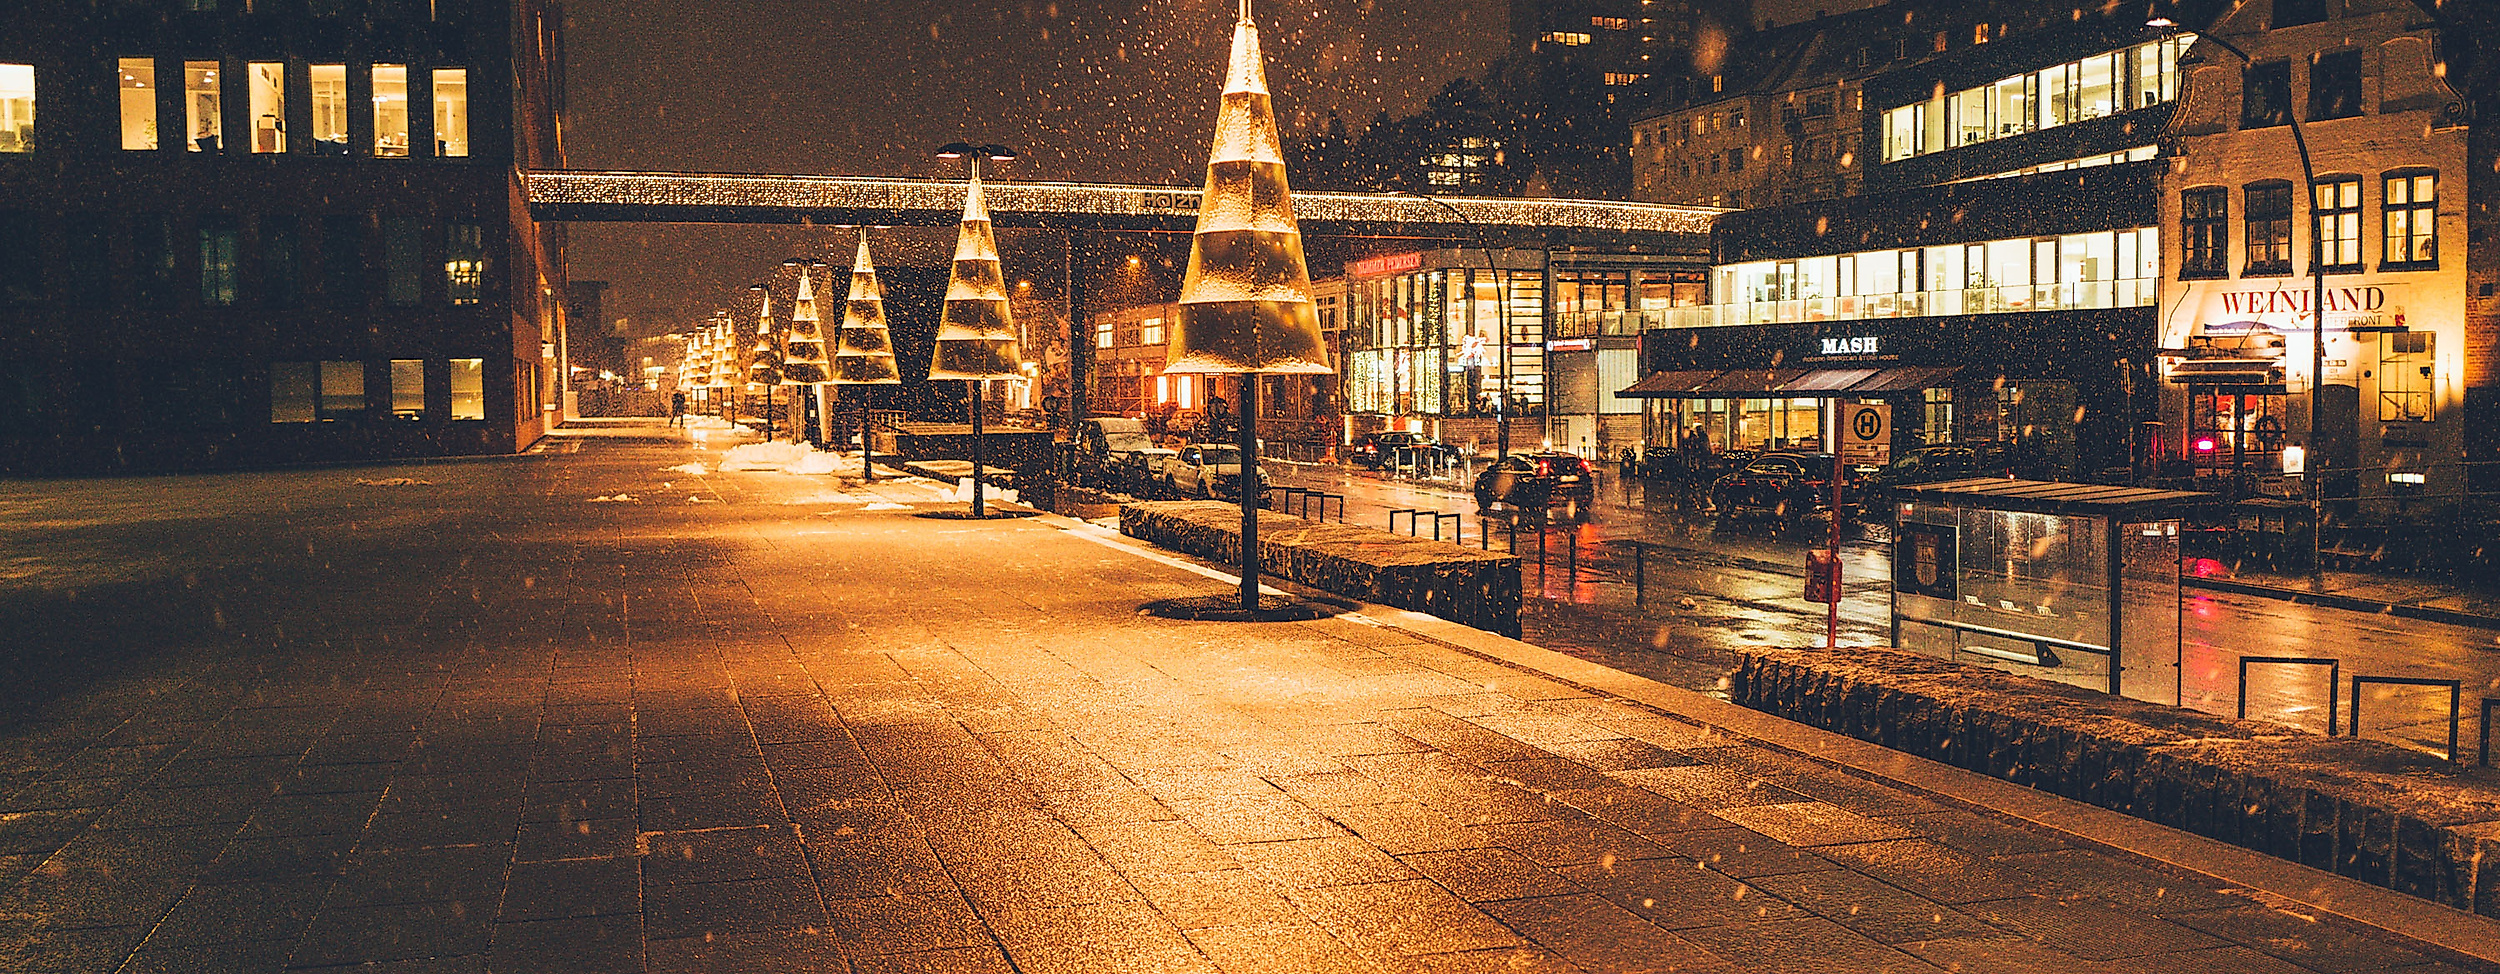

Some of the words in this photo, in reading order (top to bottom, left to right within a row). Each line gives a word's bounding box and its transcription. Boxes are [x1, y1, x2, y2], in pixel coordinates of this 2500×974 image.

[2221, 286, 2386, 315] WEINLAND
[1821, 336, 1879, 354] MASH
[1860, 415, 1874, 433] H
